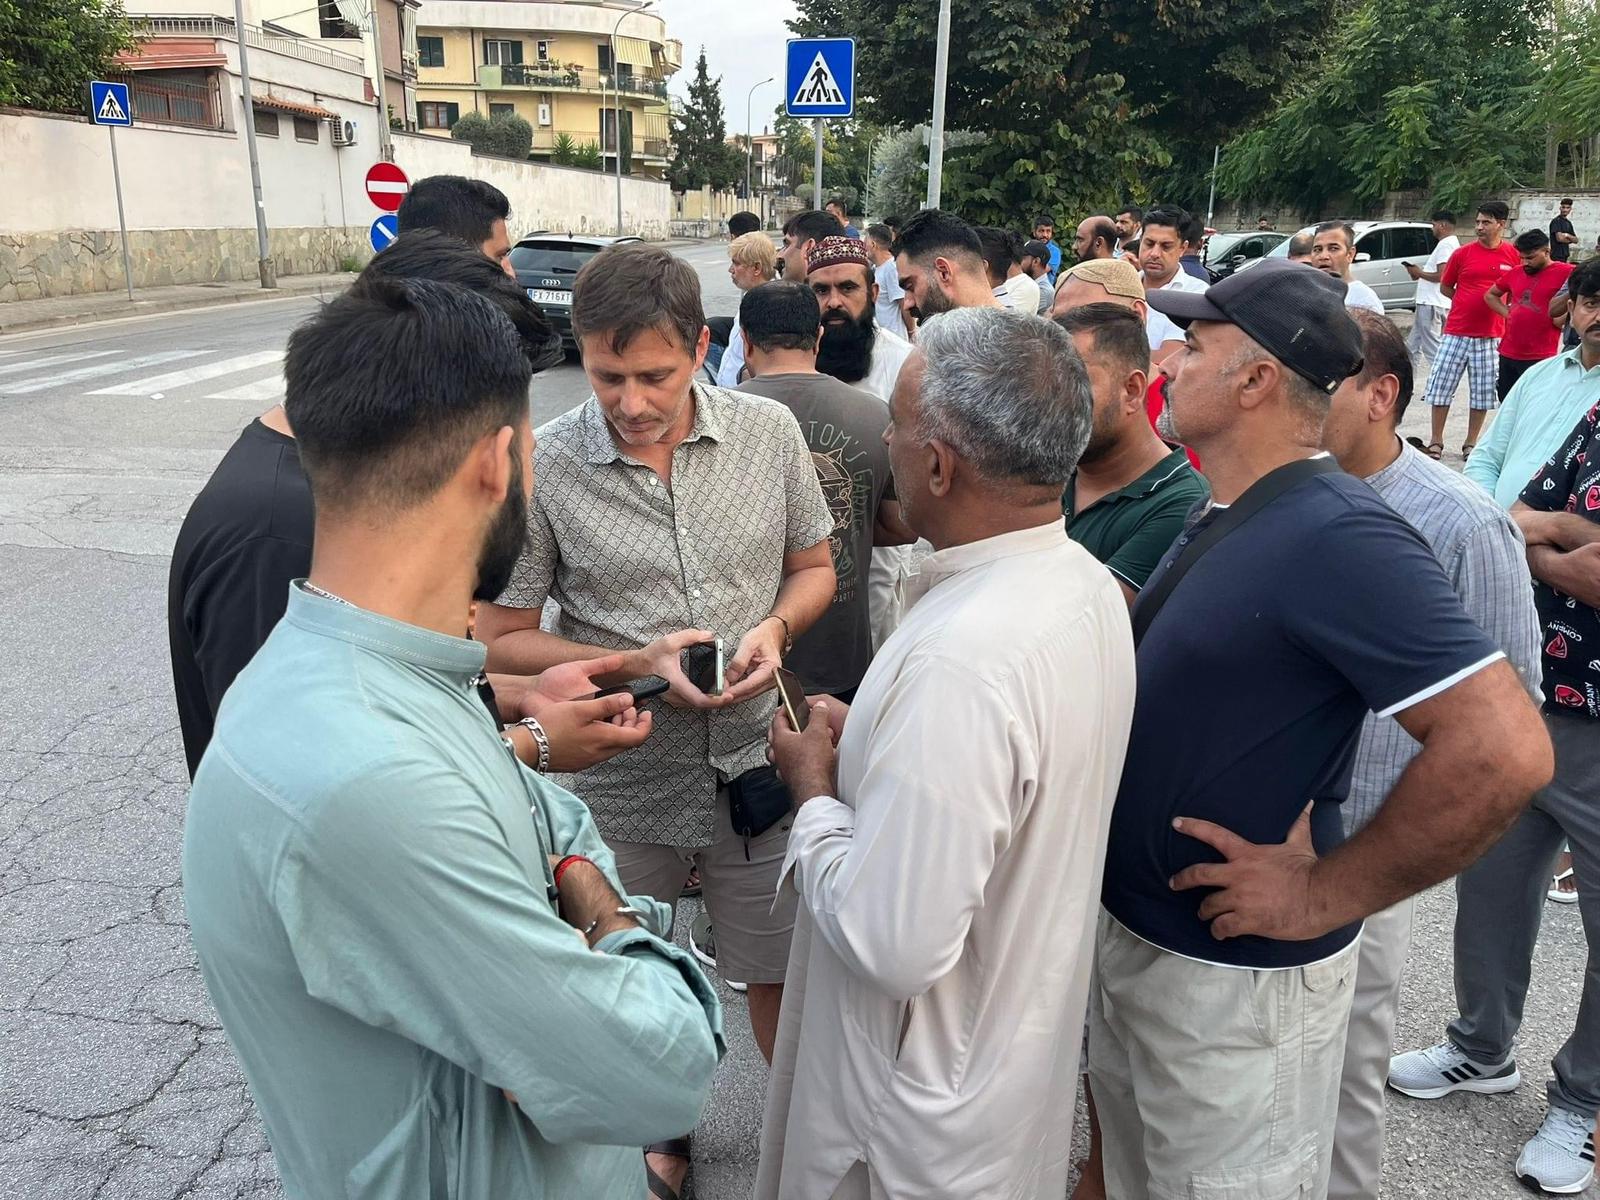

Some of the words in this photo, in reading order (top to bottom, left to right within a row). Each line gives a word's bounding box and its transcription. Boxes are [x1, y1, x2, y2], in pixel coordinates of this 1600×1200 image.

[799, 421, 867, 463] TOM'S
[1564, 434, 1585, 470] COMPANY
[1547, 621, 1582, 641] COMPANY
